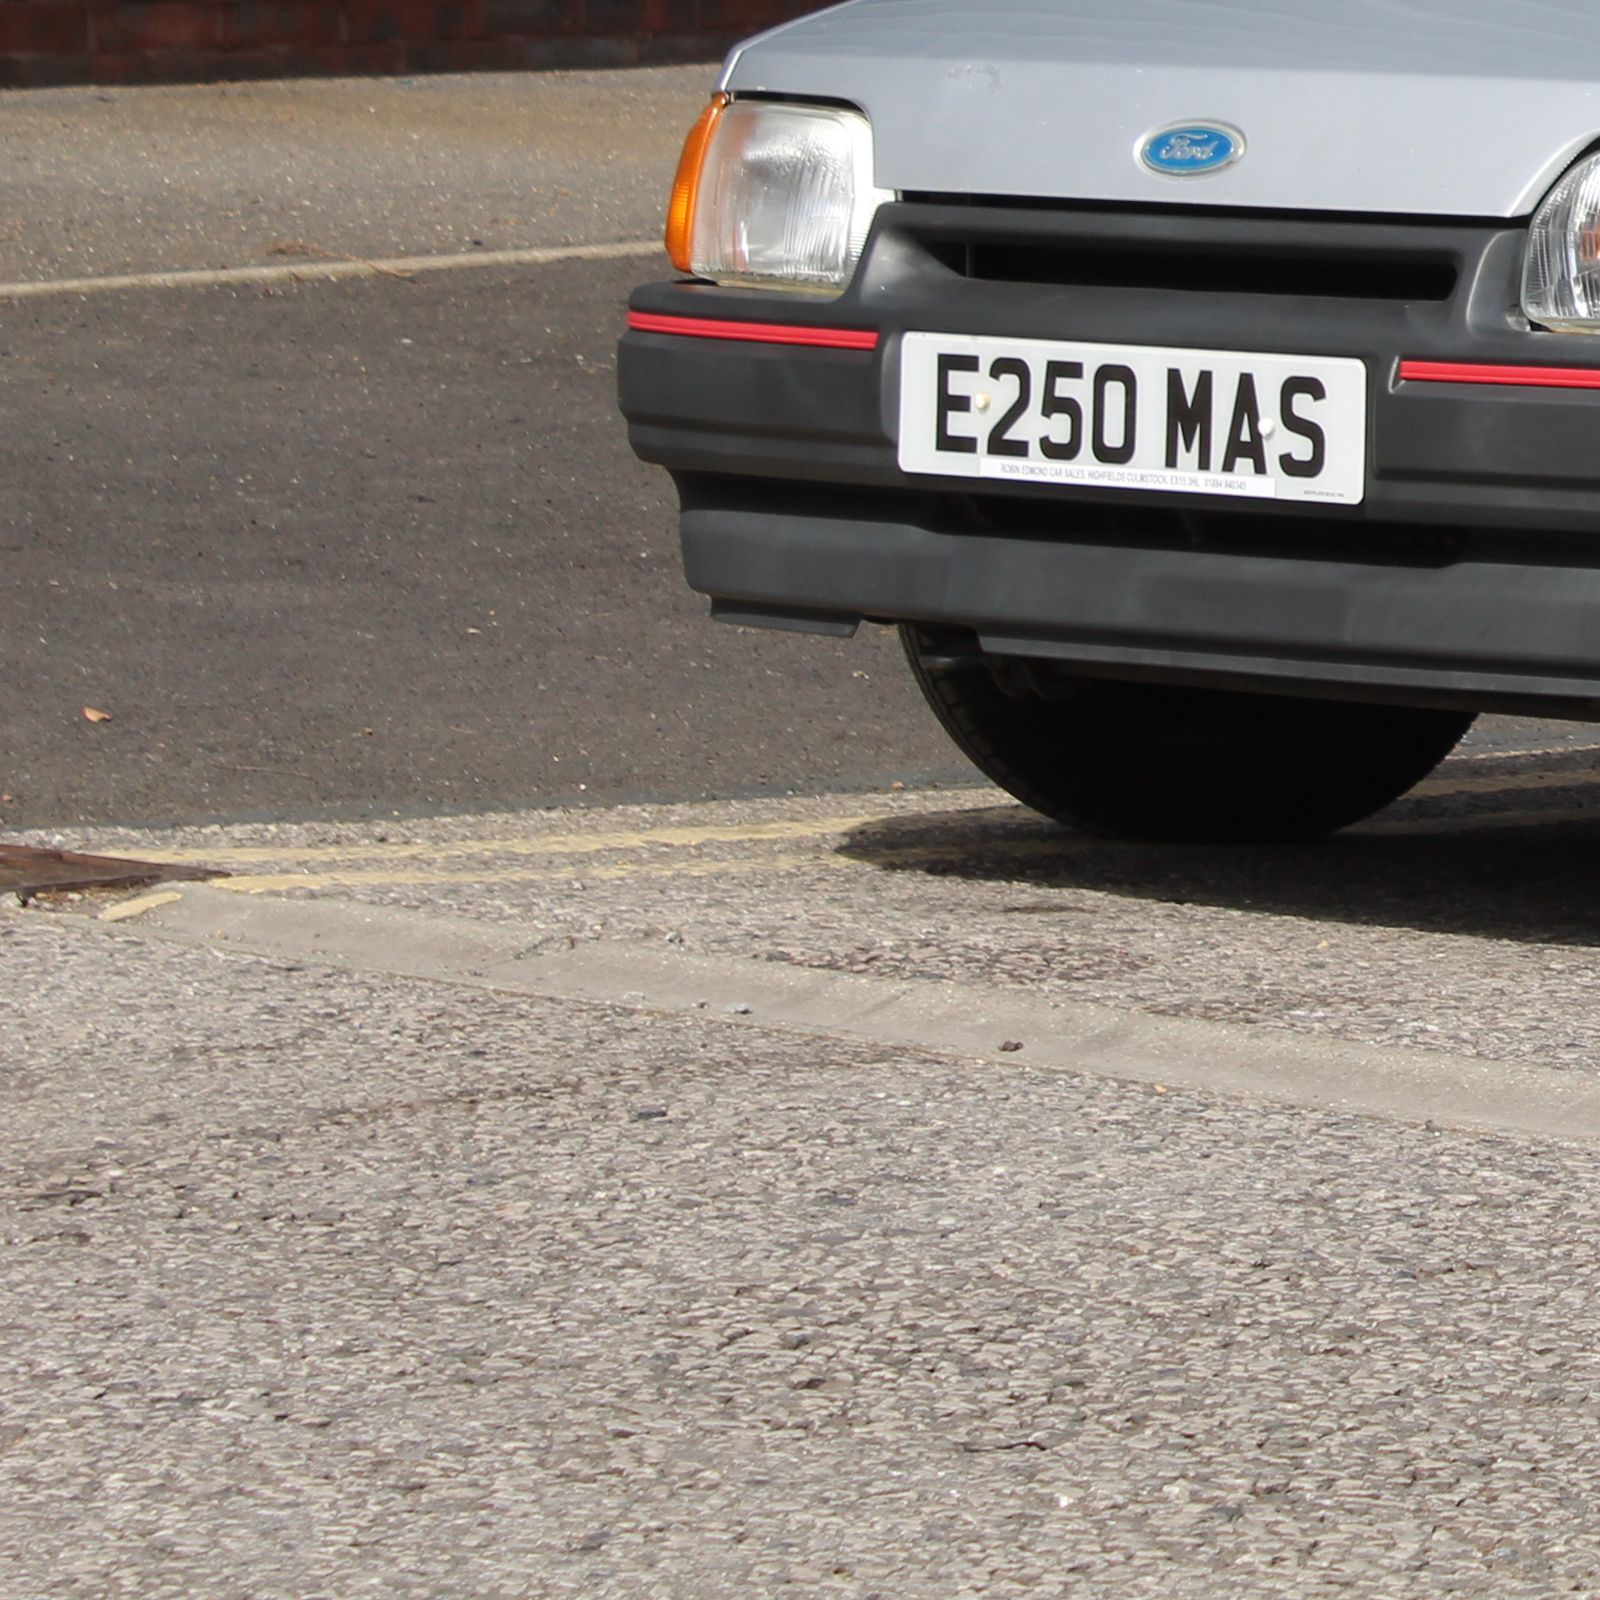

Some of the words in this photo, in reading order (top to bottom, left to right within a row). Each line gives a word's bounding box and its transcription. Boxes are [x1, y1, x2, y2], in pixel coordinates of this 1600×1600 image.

[1160, 133, 1218, 159] Ford
[935, 352, 1137, 464] E250
[1165, 367, 1327, 479] MAS
